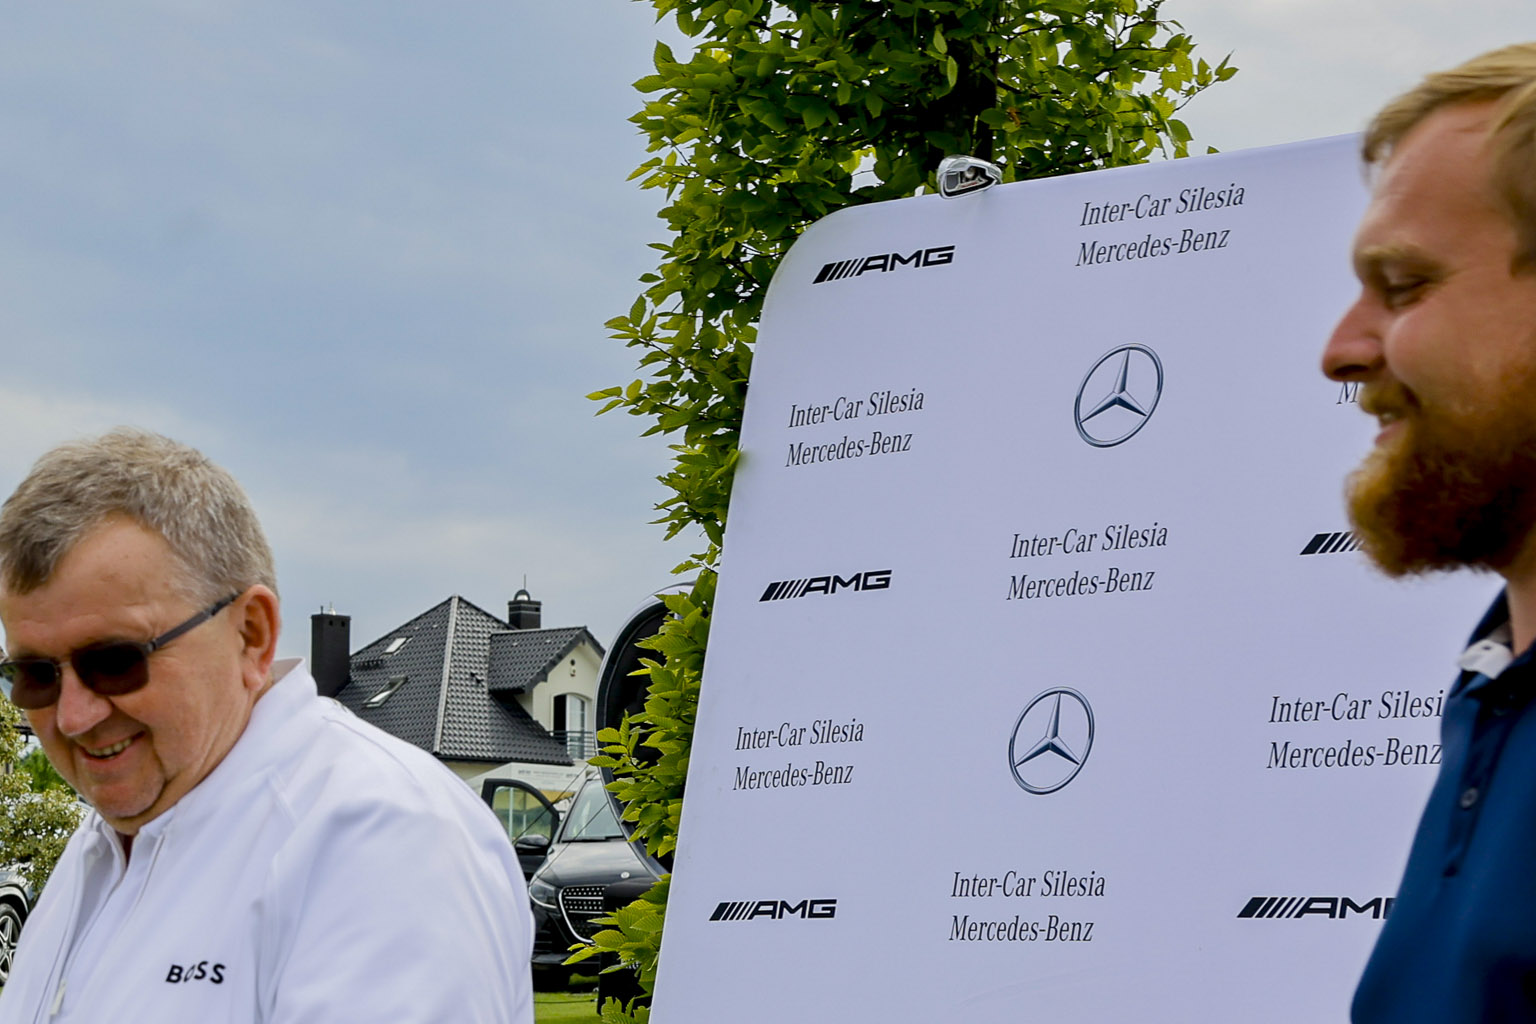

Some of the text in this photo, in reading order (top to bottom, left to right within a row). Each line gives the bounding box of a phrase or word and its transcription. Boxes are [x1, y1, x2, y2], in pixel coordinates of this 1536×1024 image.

[1080, 183, 1244, 226] Inter-Car Silesia
[855, 245, 955, 276] AMG
[1075, 229, 1230, 266] Mercedes-Benz
[789, 388, 924, 427] Inter-Car Silesia
[785, 431, 912, 467] Mercedes-Benz
[1010, 522, 1167, 558] Inter-Car Silesia
[799, 570, 892, 597] AMG
[1006, 568, 1155, 600] Mercedes-Benz
[1268, 690, 1444, 723] Inter-Car Silesi
[735, 718, 863, 750] Inter-Car Silesia
[1266, 738, 1442, 768] Mercedes-Benz
[733, 761, 854, 790] Mercedes-Benz
[951, 871, 1105, 897] Inter-Car Silesia
[747, 899, 837, 920] AMG
[1293, 897, 1390, 919] AM
[949, 914, 1094, 942] Mercedes-Benz
